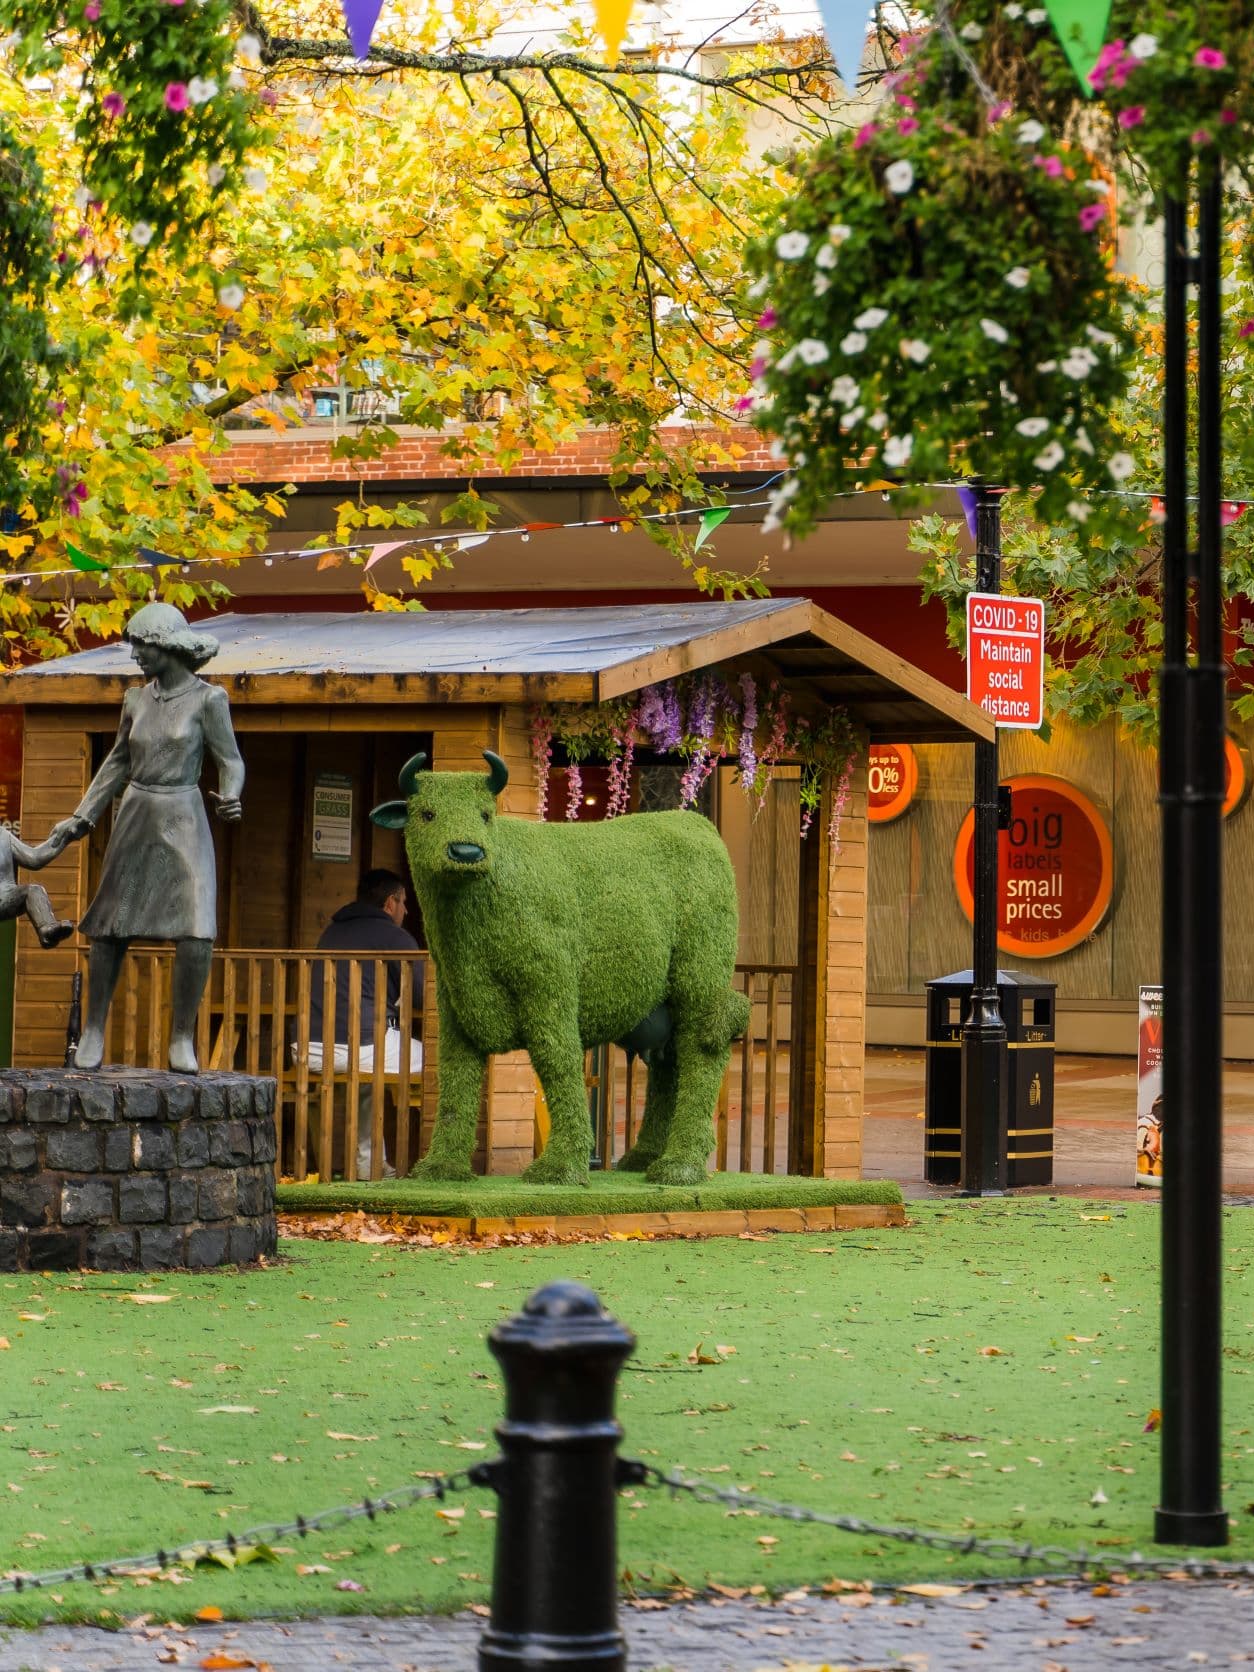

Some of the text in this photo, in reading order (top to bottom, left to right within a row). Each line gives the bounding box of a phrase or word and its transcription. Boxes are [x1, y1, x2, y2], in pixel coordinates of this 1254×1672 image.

[973, 605, 1016, 629] COVID
[1025, 610, 1038, 631] 19
[980, 639, 1032, 663] Maintain
[988, 669, 1023, 690] social
[980, 694, 1030, 717] distance
[891, 755, 900, 764] to
[1007, 851, 1063, 870] labels
[1007, 873, 1062, 897] small
[1006, 898, 1062, 924] prices
